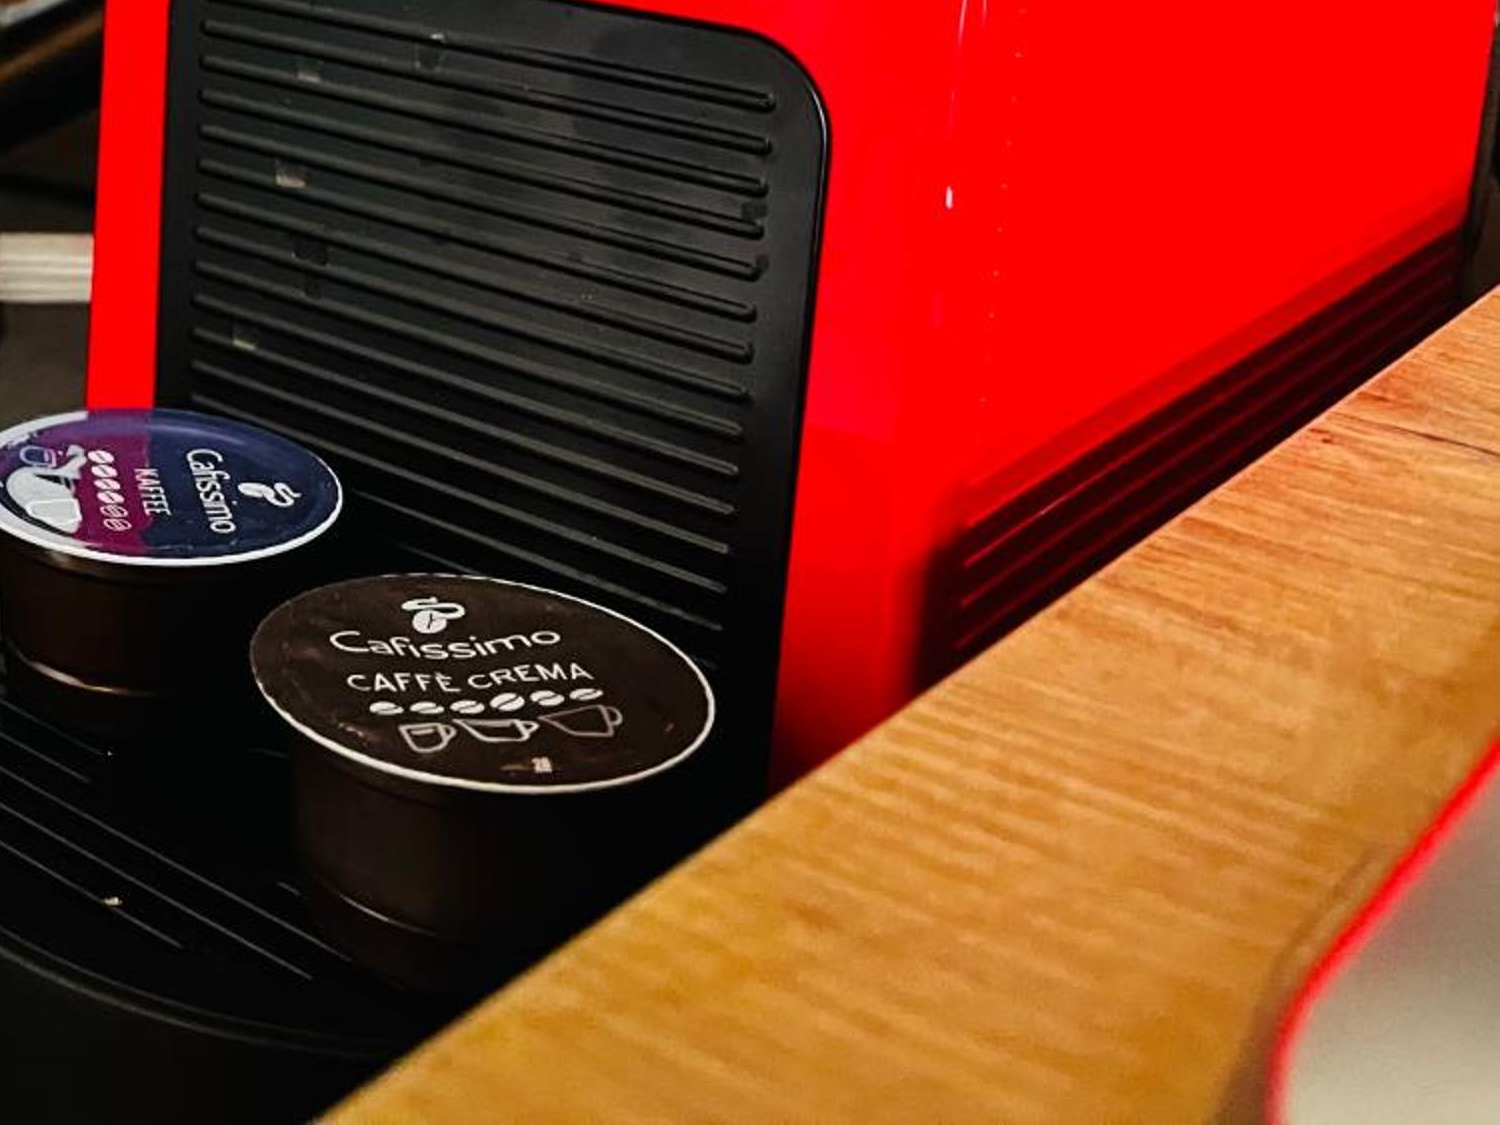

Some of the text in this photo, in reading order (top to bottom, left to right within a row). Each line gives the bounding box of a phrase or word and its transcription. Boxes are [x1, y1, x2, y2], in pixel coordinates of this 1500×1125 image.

[133, 467, 171, 517] KAFFEE
[186, 447, 237, 535] Cafissimo
[329, 629, 562, 660] Cafissimo
[466, 663, 595, 690] CREMA
